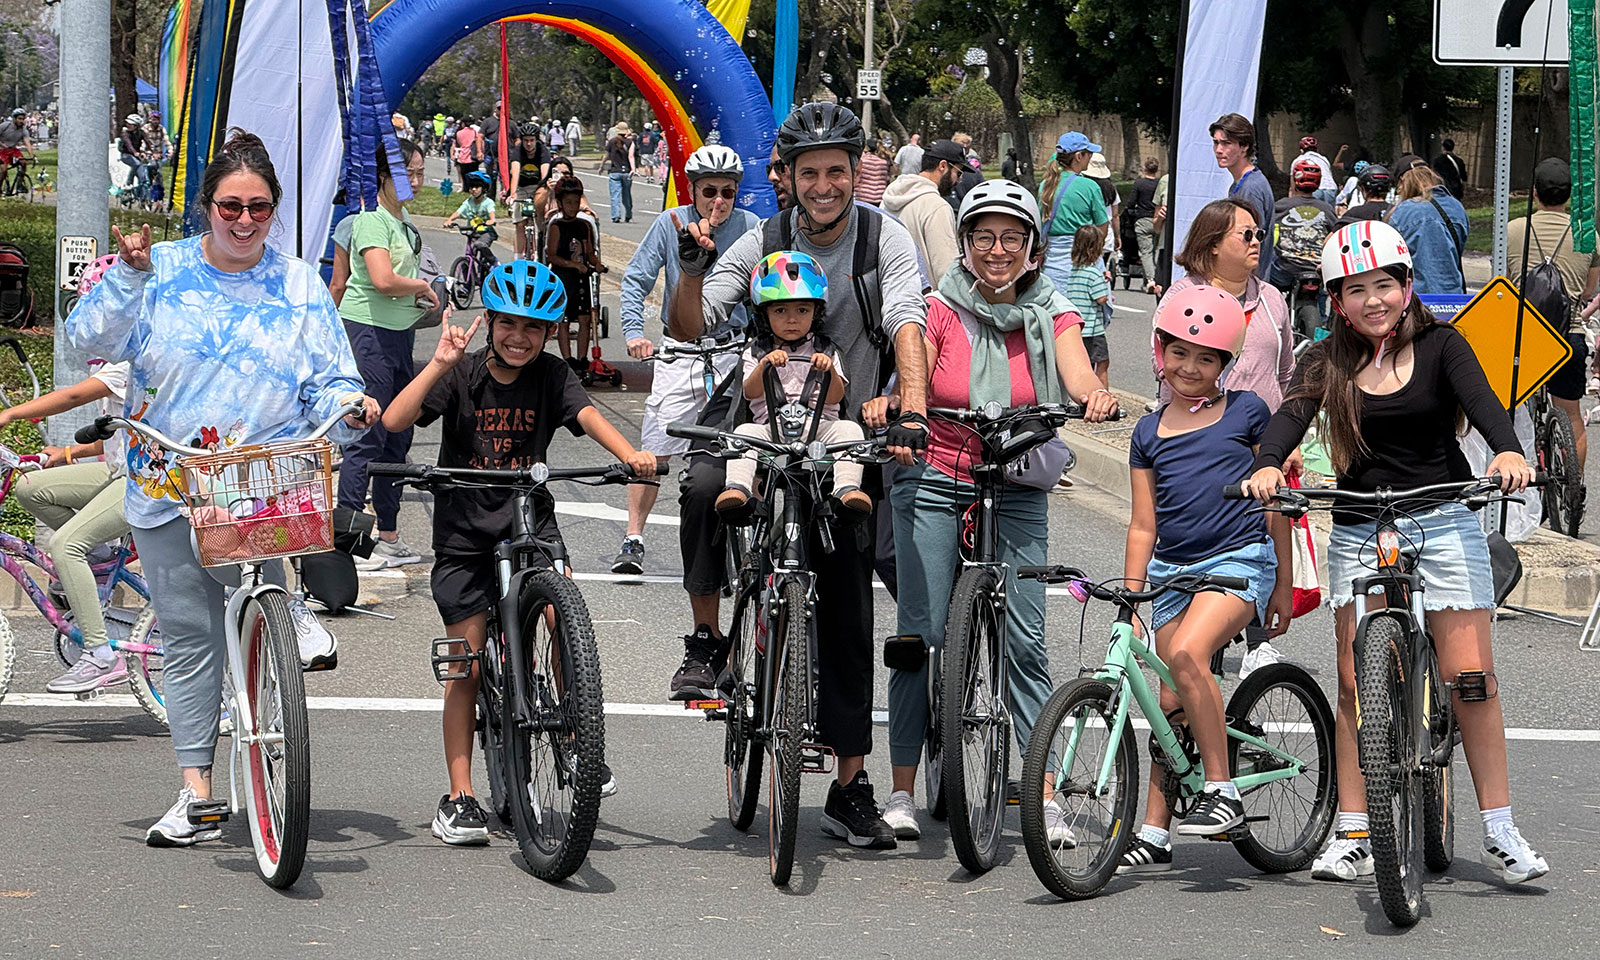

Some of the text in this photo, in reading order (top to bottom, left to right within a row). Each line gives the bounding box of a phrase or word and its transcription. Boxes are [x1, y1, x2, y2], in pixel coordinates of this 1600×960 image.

[860, 85, 878, 96] 55
[475, 408, 535, 431] TEXAS
[492, 437, 513, 453] VS
[697, 631, 709, 639] 23
[858, 777, 868, 785] 23
